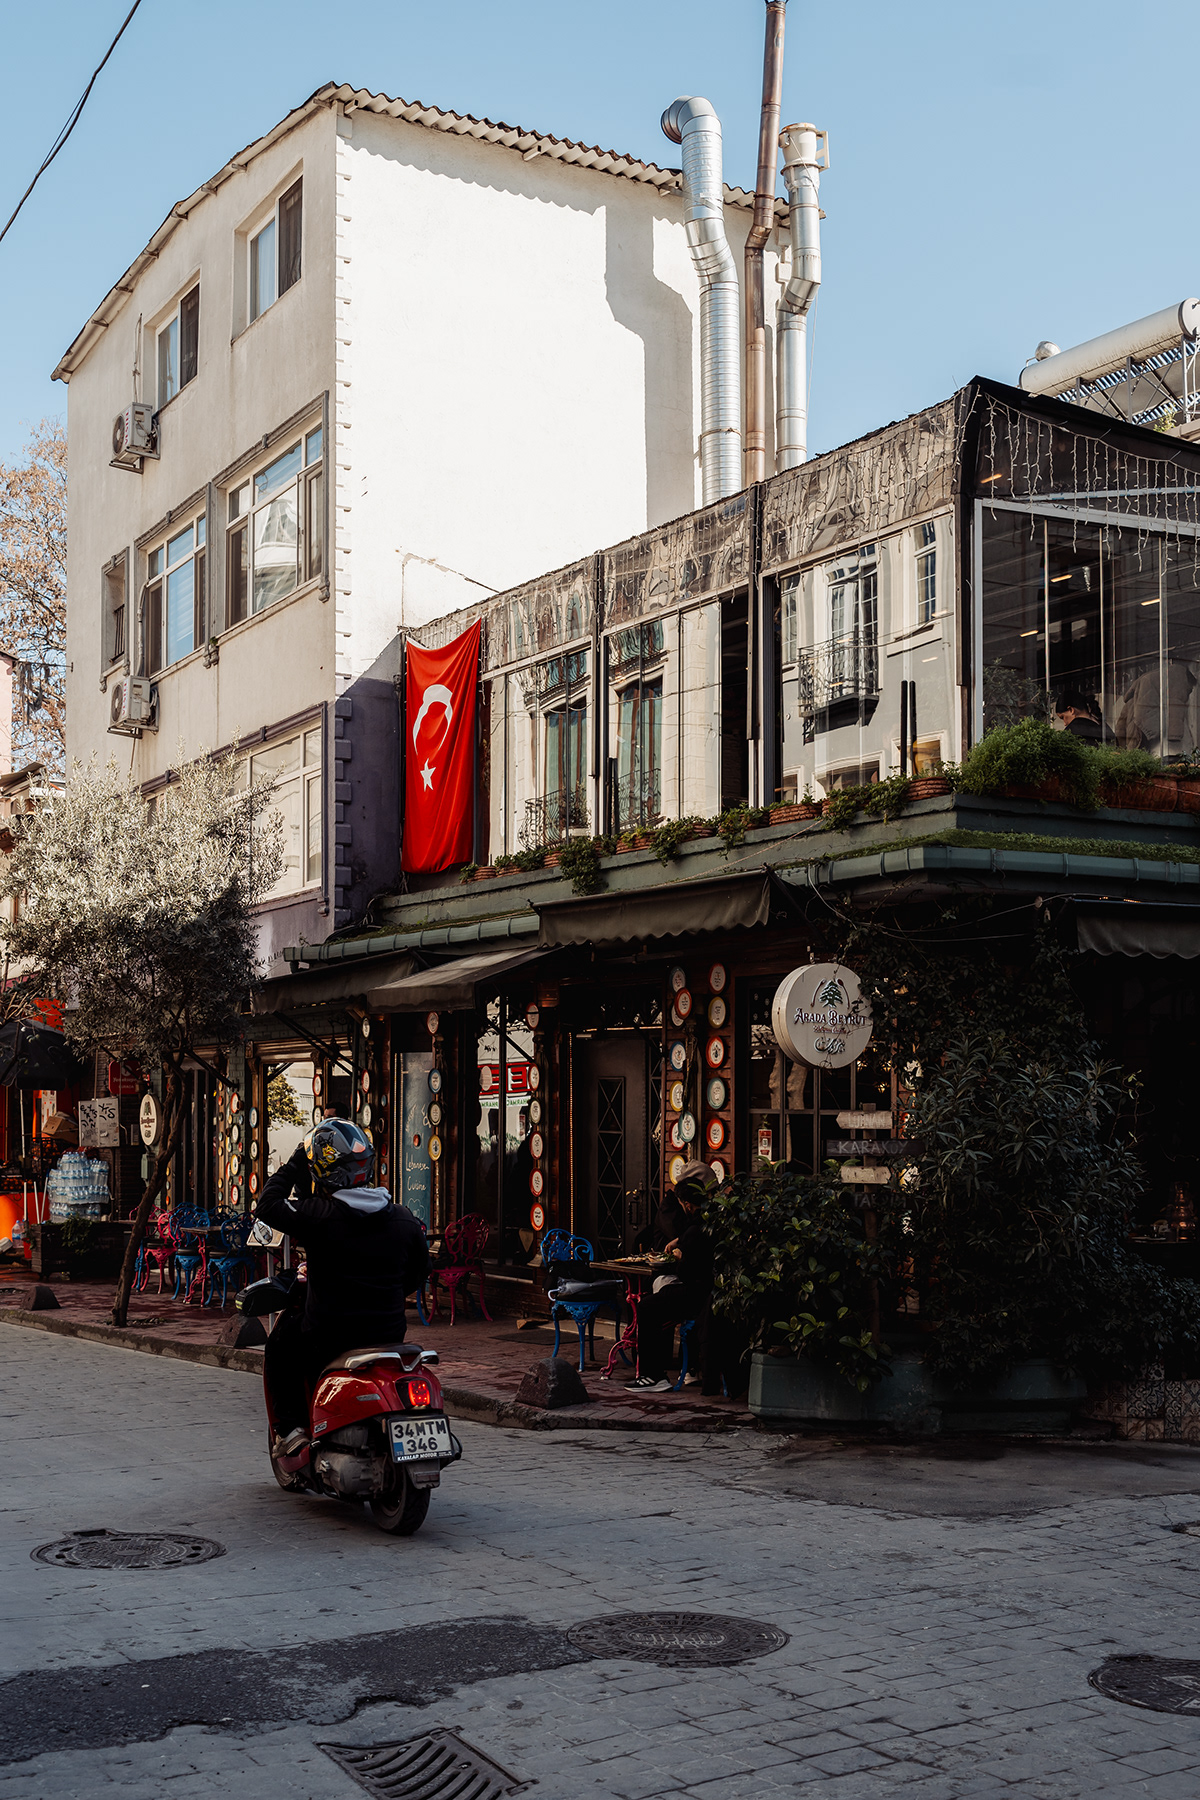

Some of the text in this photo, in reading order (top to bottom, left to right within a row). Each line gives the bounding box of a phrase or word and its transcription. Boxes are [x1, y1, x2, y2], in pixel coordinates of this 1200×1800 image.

[794, 1008, 867, 1026] ARADA BEYRUT
[407, 1437, 438, 1453] 346
